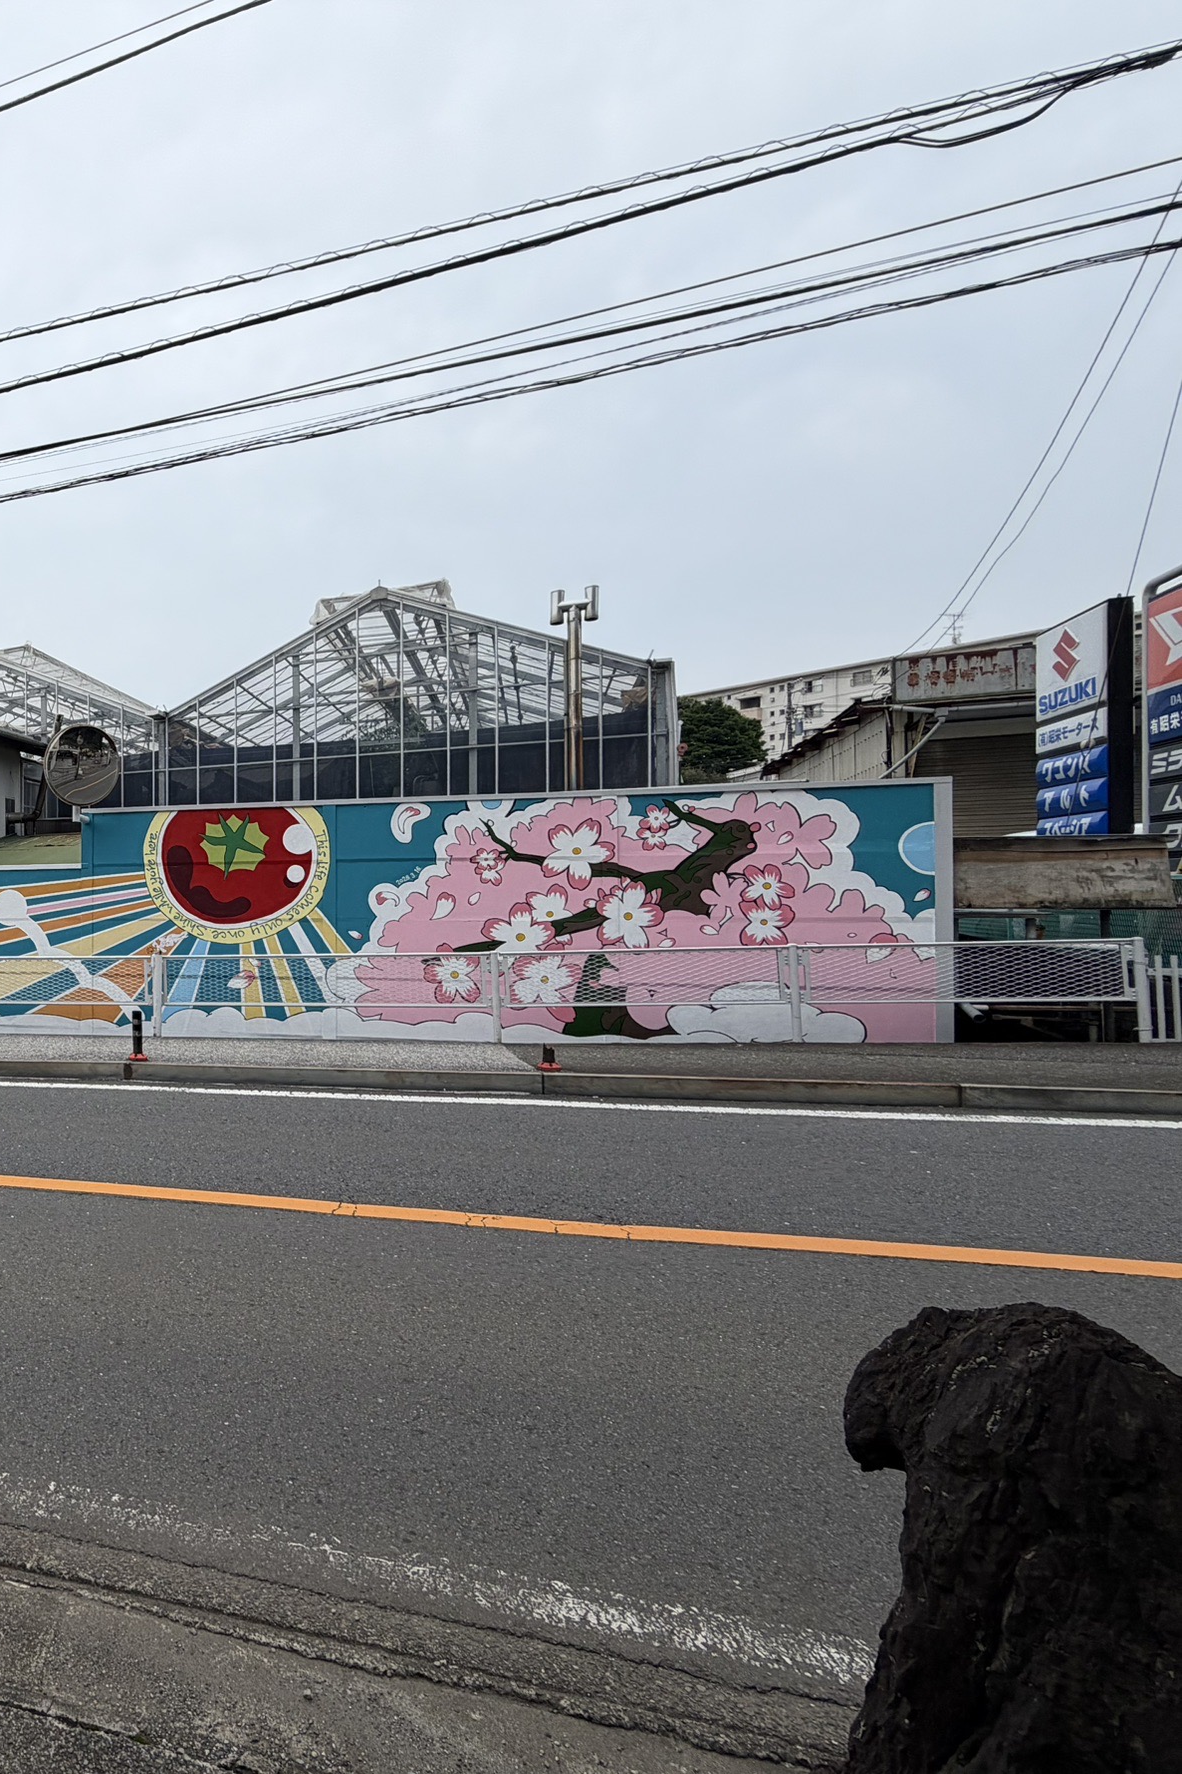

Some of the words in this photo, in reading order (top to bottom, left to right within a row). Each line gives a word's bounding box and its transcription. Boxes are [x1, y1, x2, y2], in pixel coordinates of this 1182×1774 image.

[1039, 677, 1097, 714] SUZUKI
[1150, 711, 1182, 735] 有昭栄
[1043, 785, 1089, 812] アルト
[315, 829, 328, 858] This
[314, 860, 329, 881] life
[285, 885, 319, 921] comes
[173, 911, 208, 937] Shine
[249, 919, 283, 936] only
